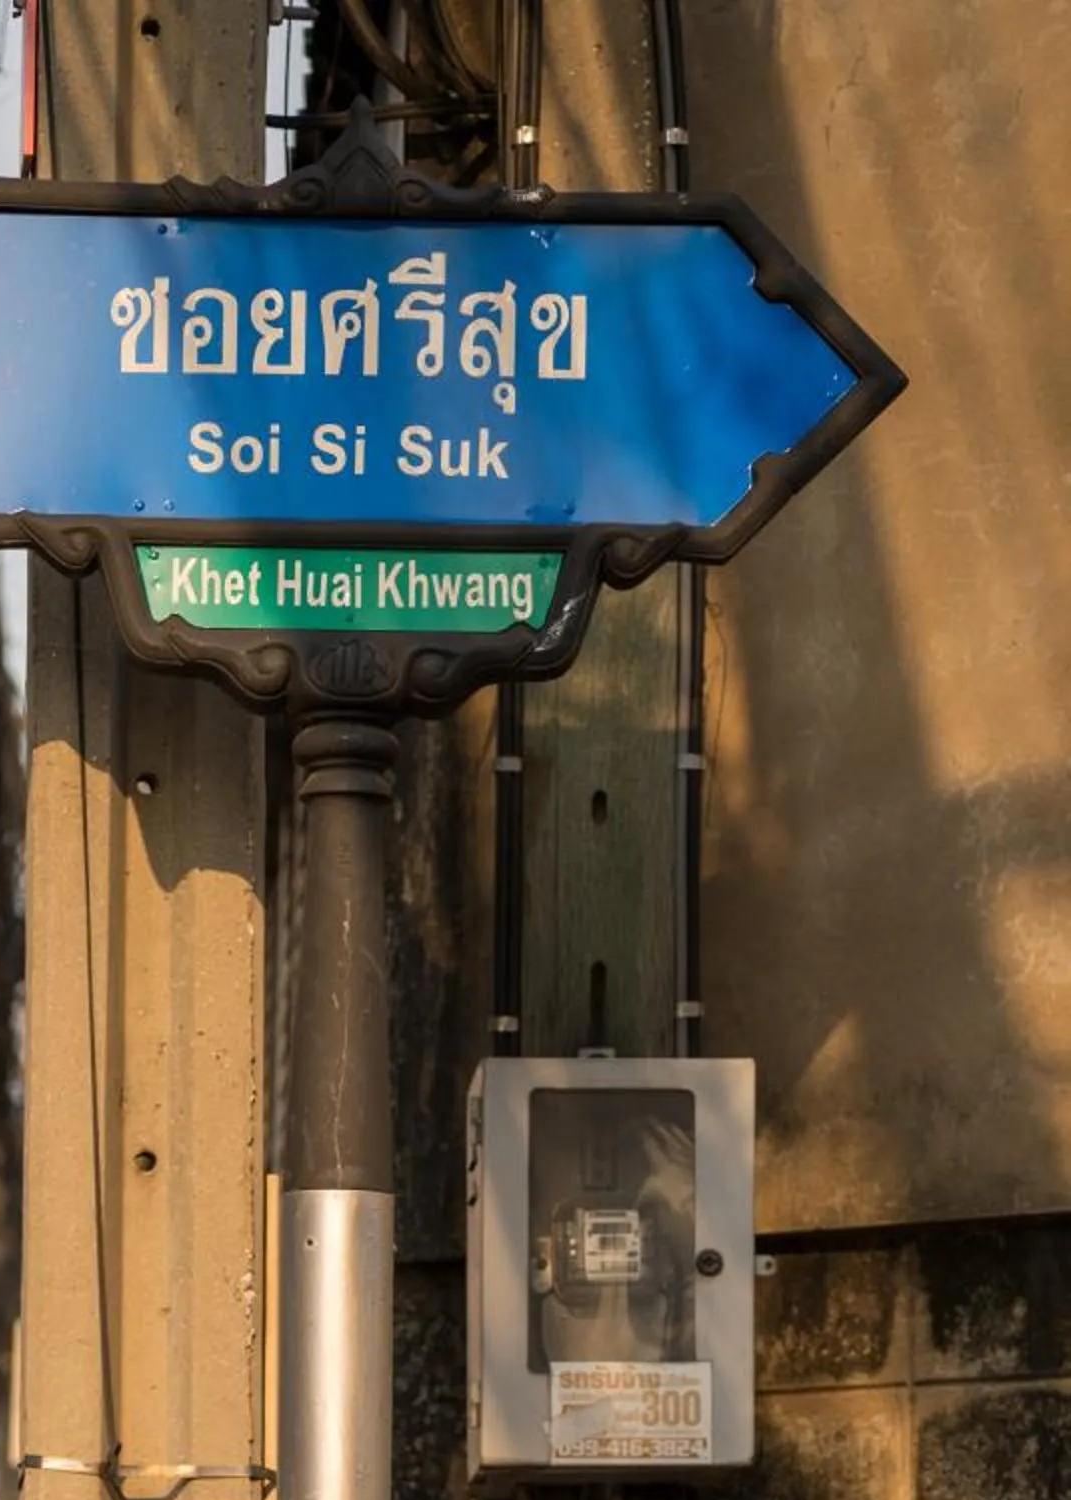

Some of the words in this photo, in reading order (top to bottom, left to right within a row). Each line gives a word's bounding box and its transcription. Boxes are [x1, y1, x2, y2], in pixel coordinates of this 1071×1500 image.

[111, 252, 588, 415] ซอยศรีสุข
[187, 421, 281, 475] Soi
[310, 423, 367, 476] Si
[396, 425, 510, 480] Suk
[171, 556, 262, 606] Khet
[276, 559, 363, 609] Huai
[377, 559, 534, 620] Khwang
[641, 1389, 702, 1427] 300
